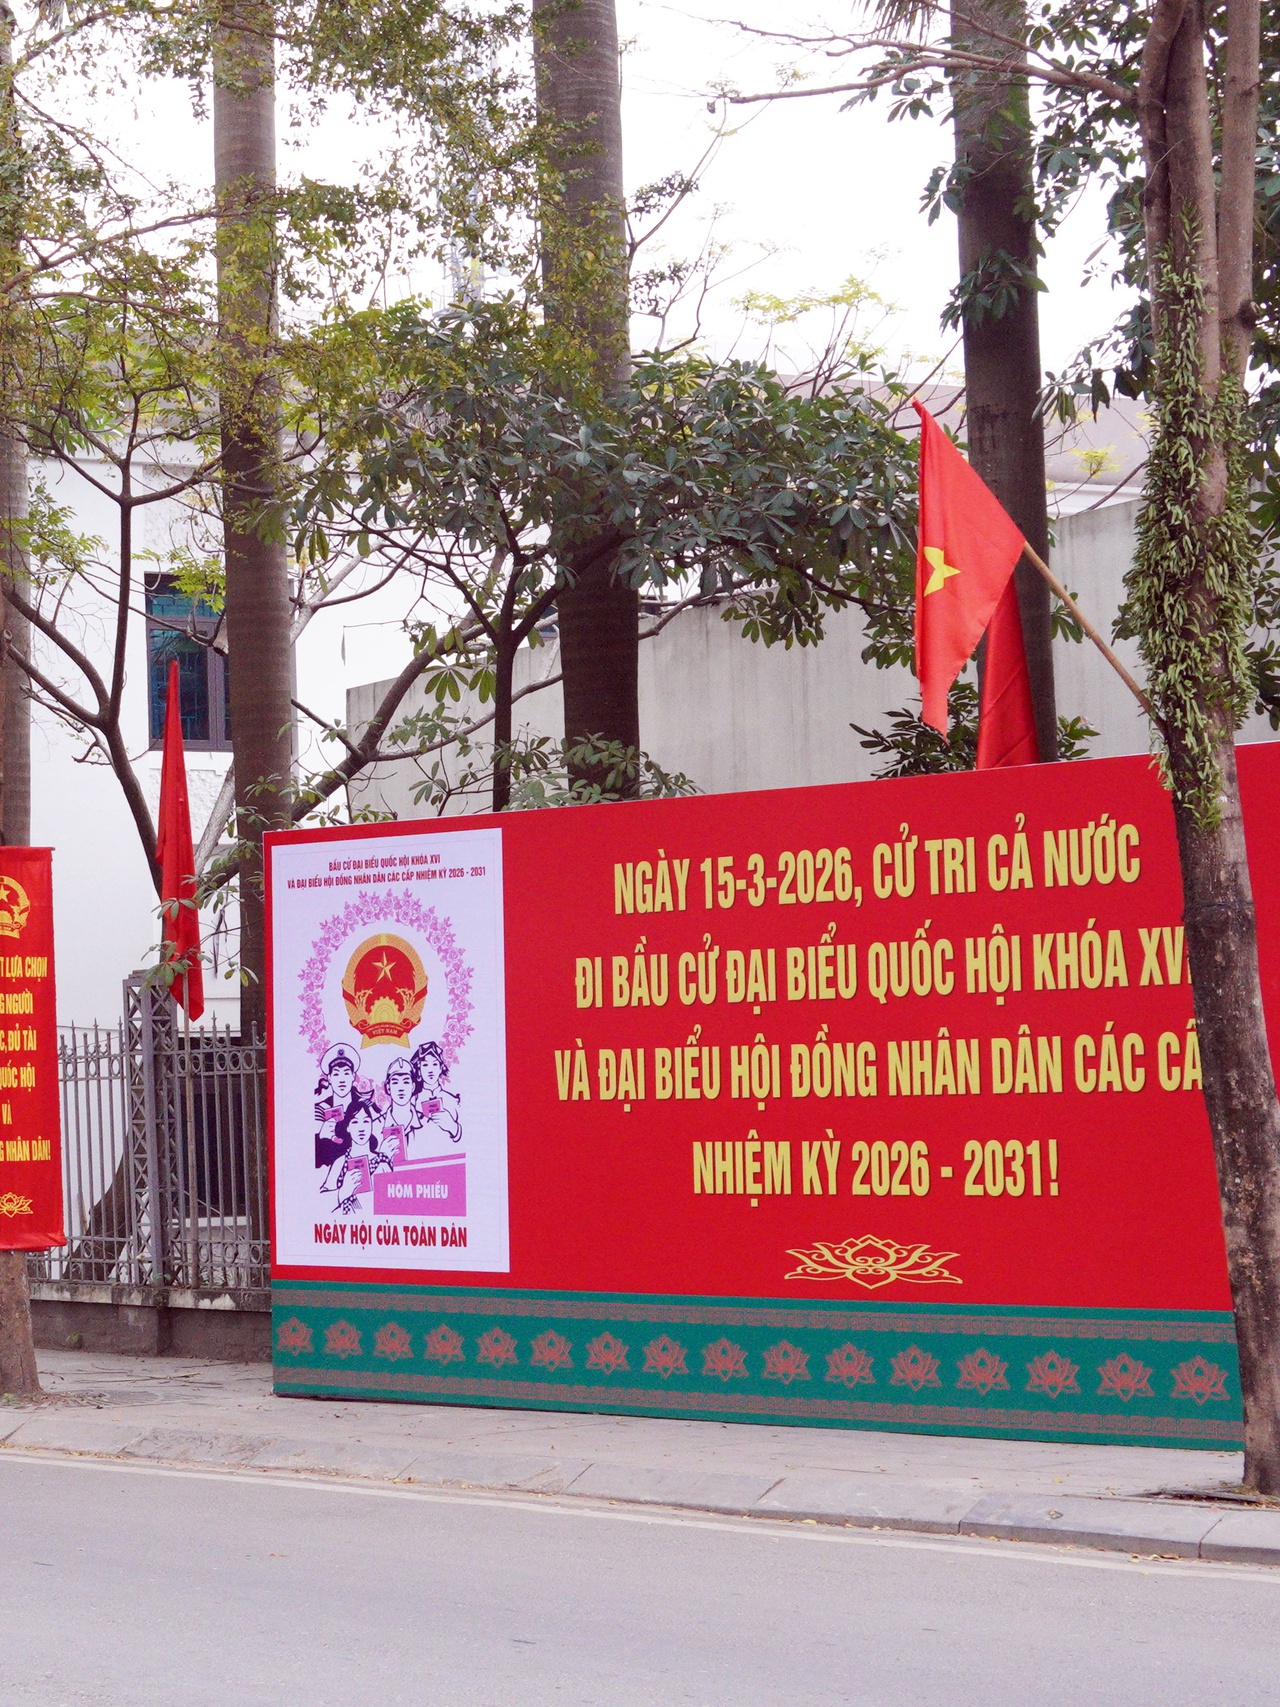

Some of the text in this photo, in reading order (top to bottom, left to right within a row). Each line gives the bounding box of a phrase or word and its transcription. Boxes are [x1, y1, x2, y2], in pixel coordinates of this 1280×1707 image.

[329, 854, 440, 872] BẦU CỬ ĐẠI BIỂU QUỐC HỘI KHÓA XVI
[615, 813, 1141, 915] NGÀY 15-3-2026, CỬ TRI CẢ NƯỚC
[6, 955, 23, 982] LỰA
[25, 957, 48, 982] CHỌN
[575, 918, 1193, 1015] ĐI BẦU CỬ ĐẠI BIỂU QUỐC HỘI KHÓA XV
[6, 988, 33, 1014] NGƯỜI
[20, 1062, 35, 1092] HỘI
[554, 1038, 591, 1101] VÀ
[598, 1048, 646, 1113] ĐẠI
[655, 1024, 721, 1100] BIỂU
[730, 1032, 781, 1111] HỘI
[790, 1023, 878, 1098] ĐỒNG
[887, 1026, 981, 1096] NHÂN
[990, 1024, 1063, 1094] DÂN
[1073, 1021, 1146, 1093] CÁC
[2, 1100, 12, 1124] VÀ
[6, 1136, 30, 1161] NHÂN
[32, 1136, 51, 1161] DÂN!
[692, 1128, 1059, 1208] NHIỆM KỲ 2026 - 2031!
[388, 1180, 449, 1199] HÒM PHIẾU
[314, 1219, 467, 1250] NGÀY HỘI CỦA TOÀN DÂN
